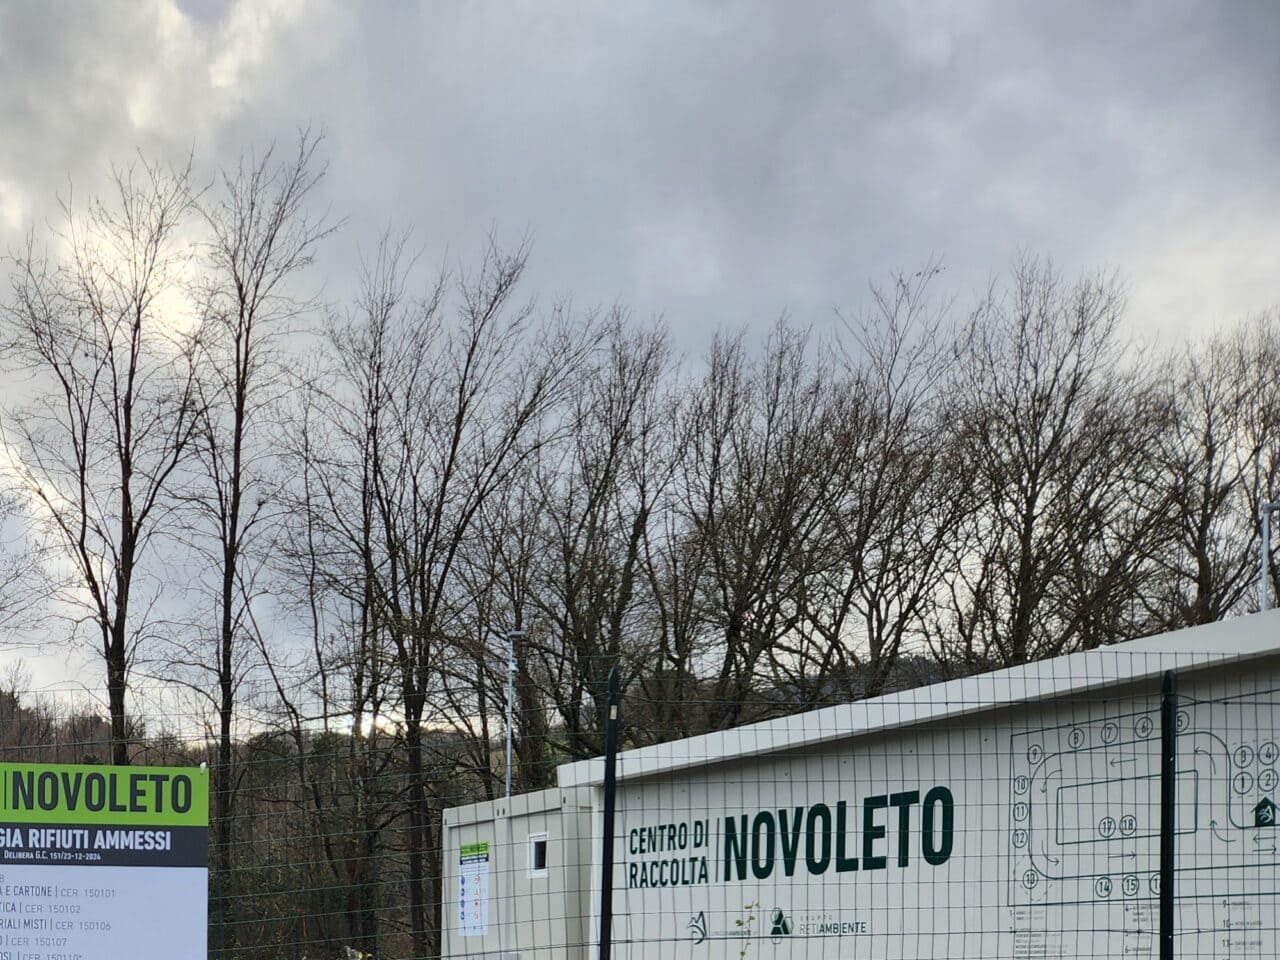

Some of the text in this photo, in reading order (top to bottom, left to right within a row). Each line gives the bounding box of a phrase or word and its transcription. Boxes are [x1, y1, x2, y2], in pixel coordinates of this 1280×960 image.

[12, 770, 192, 814] NOVOLETO
[28, 828, 88, 849] RIFIUTI
[94, 830, 171, 850] AMMESSI
[629, 819, 708, 855] CENTRO DI
[724, 786, 954, 882] NOVOLETO
[629, 856, 708, 888] RACCOLTA
[6, 886, 11, 896] E
[13, 886, 52, 897] CARTONE
[61, 888, 78, 897] CER
[25, 905, 42, 913] CER
[24, 920, 47, 930] MISTI
